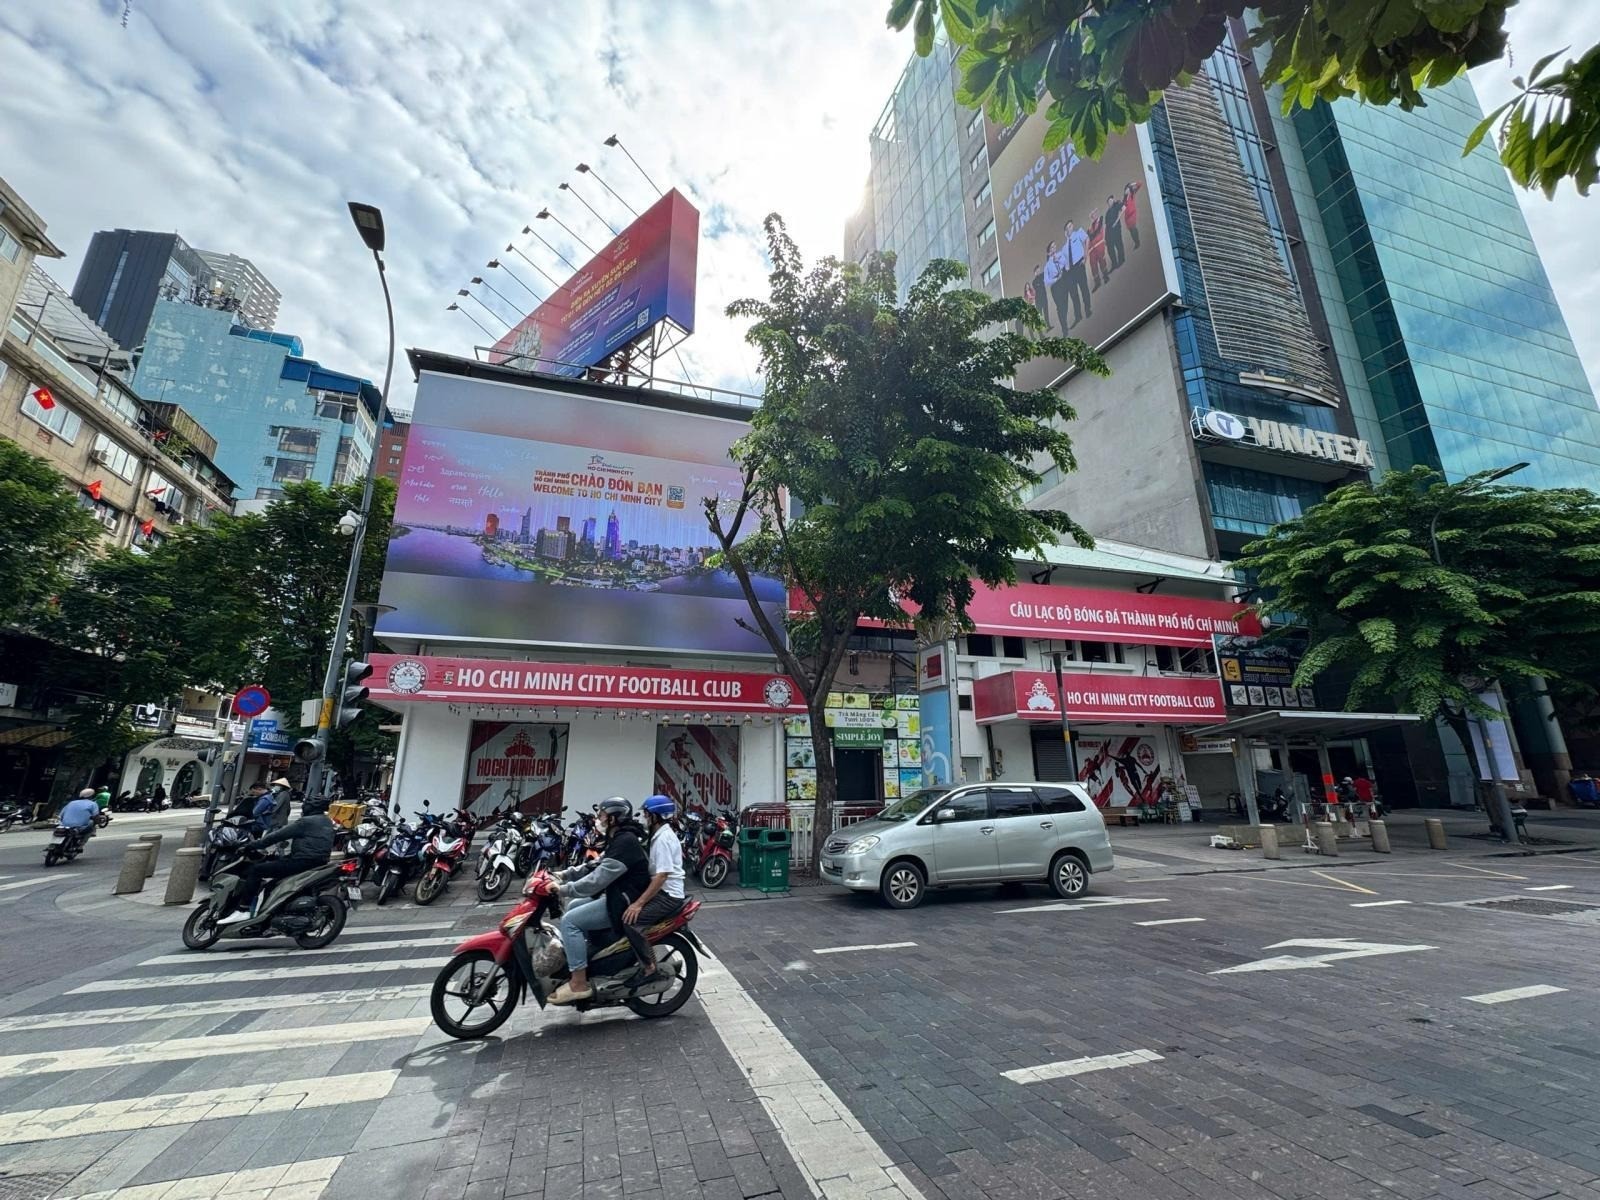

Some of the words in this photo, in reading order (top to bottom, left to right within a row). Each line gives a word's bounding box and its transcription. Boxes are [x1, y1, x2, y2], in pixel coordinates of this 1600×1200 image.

[1247, 416, 1376, 467] VINATEX
[571, 473, 605, 489] CHÀO
[608, 476, 633, 492] ĐÓN
[533, 483, 574, 497] WELCOME
[577, 488, 588, 498] TO
[590, 489, 601, 499] HO
[604, 491, 618, 501] CHI
[620, 493, 642, 504] MINH
[643, 495, 663, 507] CITY
[1009, 601, 1032, 618] CÂU
[1034, 605, 1054, 623] LẠC
[1056, 606, 1071, 624] BỘ
[1074, 607, 1104, 623] BÓNG
[1105, 608, 1120, 625] ĐÁ
[1121, 608, 1156, 627] THÀNH
[1158, 611, 1179, 629] PHỐ
[1196, 616, 1213, 632] CHÍ
[1213, 619, 1240, 633] MINH
[457, 668, 485, 688] HO
[488, 670, 520, 689] CHI
[524, 672, 574, 691] MINH
[577, 674, 616, 693] CITY
[618, 676, 700, 697] FOOTBALL
[703, 680, 742, 698] CLUB
[1067, 692, 1081, 704] HO
[1083, 692, 1100, 705] CHI
[1101, 693, 1127, 706] MINH
[1128, 694, 1148, 707] CITY
[1149, 695, 1193, 708] FOOTBALL
[1193, 696, 1216, 708] CLUB
[836, 731, 865, 741] SIMPLE
[867, 731, 881, 741] JOY
